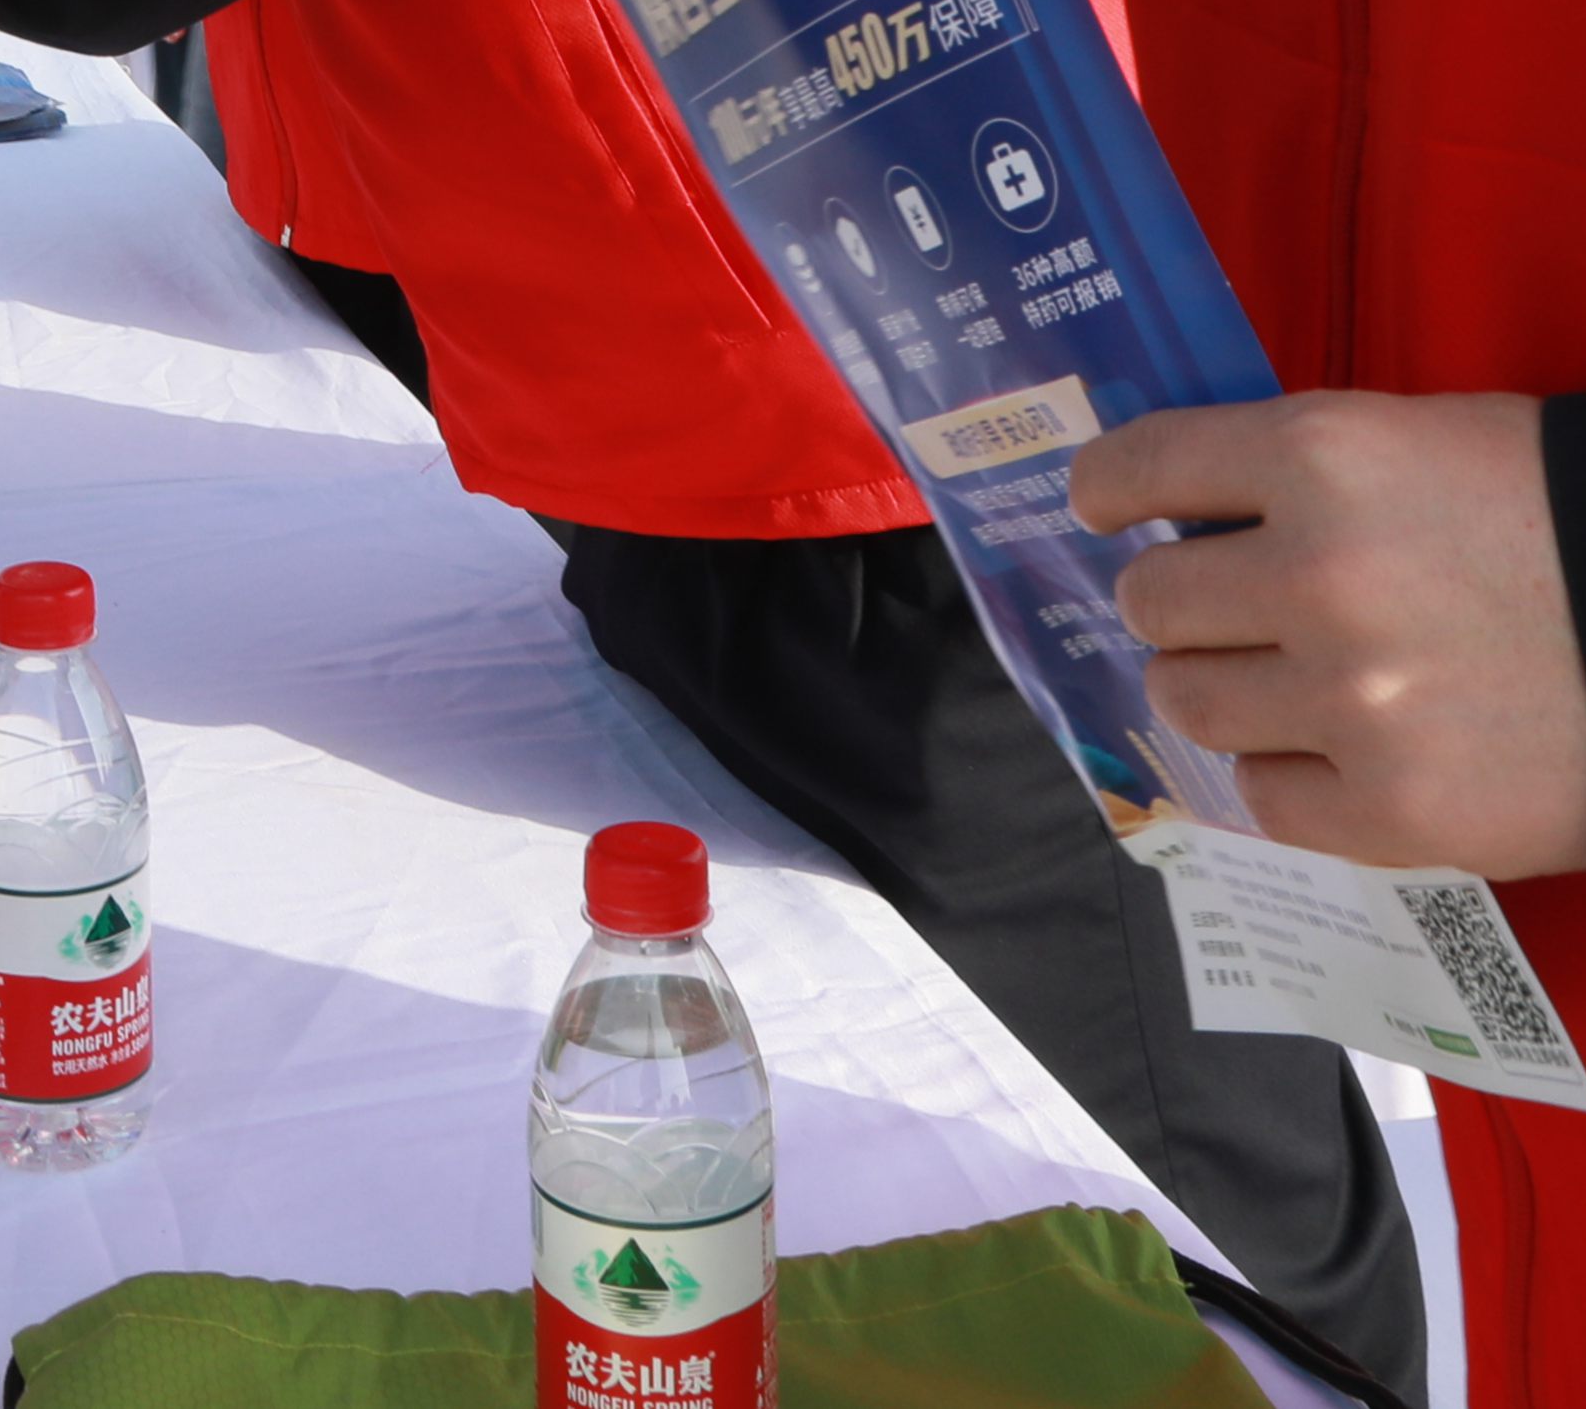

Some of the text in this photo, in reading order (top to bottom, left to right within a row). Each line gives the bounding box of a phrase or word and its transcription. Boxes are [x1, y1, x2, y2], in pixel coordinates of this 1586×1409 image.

[1011, 236, 1098, 292] 36种高额
[1022, 268, 1123, 330] 特药可报销
[50, 976, 149, 1036] 农夫山泉
[52, 1032, 114, 1057] NONGFU
[565, 1341, 713, 1397] 农夫山泉
